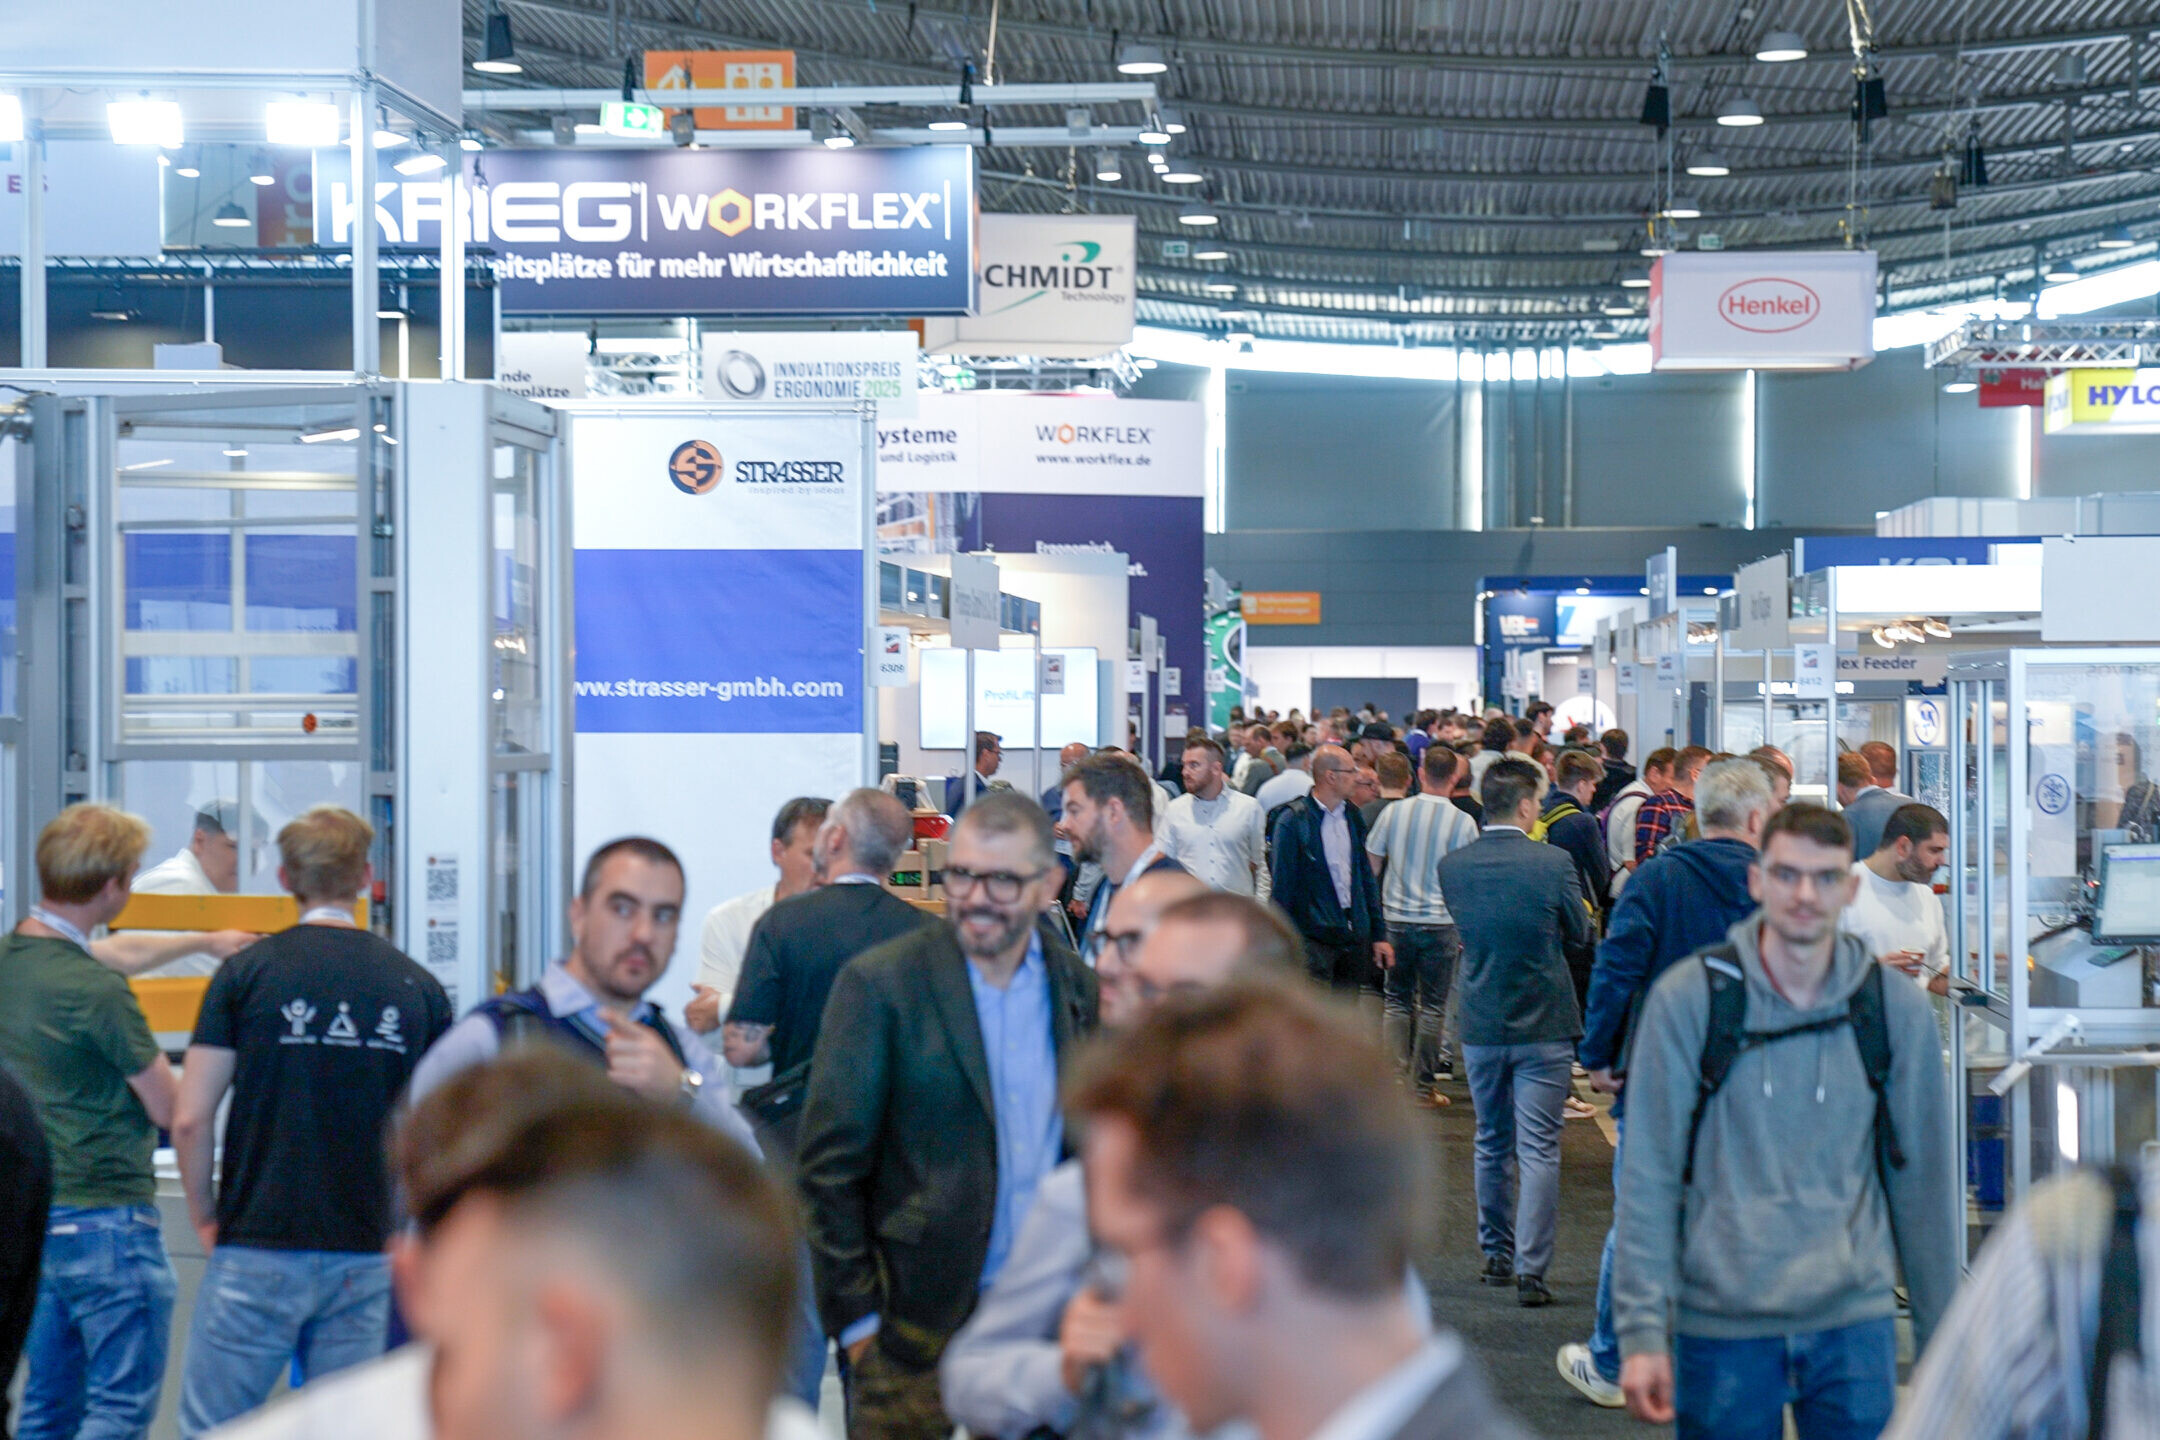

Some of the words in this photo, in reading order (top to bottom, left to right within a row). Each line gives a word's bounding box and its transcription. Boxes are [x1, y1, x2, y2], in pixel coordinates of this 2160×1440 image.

[331, 182, 632, 243] KRIEG
[656, 187, 932, 237] WORKFLEX
[616, 251, 655, 278] für
[660, 251, 726, 278] mehr
[728, 250, 948, 278] Wirtschaftlichkeit
[979, 265, 1113, 290] CHMIDT
[1061, 291, 1126, 305] Technology
[1728, 295, 1810, 315] Henkel
[773, 361, 901, 377] INNOVATIONSPREIS
[774, 380, 861, 398] ERGONOMIE
[865, 380, 901, 397] 2025
[877, 427, 957, 449] ysteme
[1036, 423, 1151, 444] WORKFLEX
[880, 450, 903, 463] und
[907, 450, 957, 465] Logistik
[1036, 453, 1151, 466] www.workflex.de
[735, 460, 844, 483] STRASSER
[1864, 657, 1917, 669] Feeder
